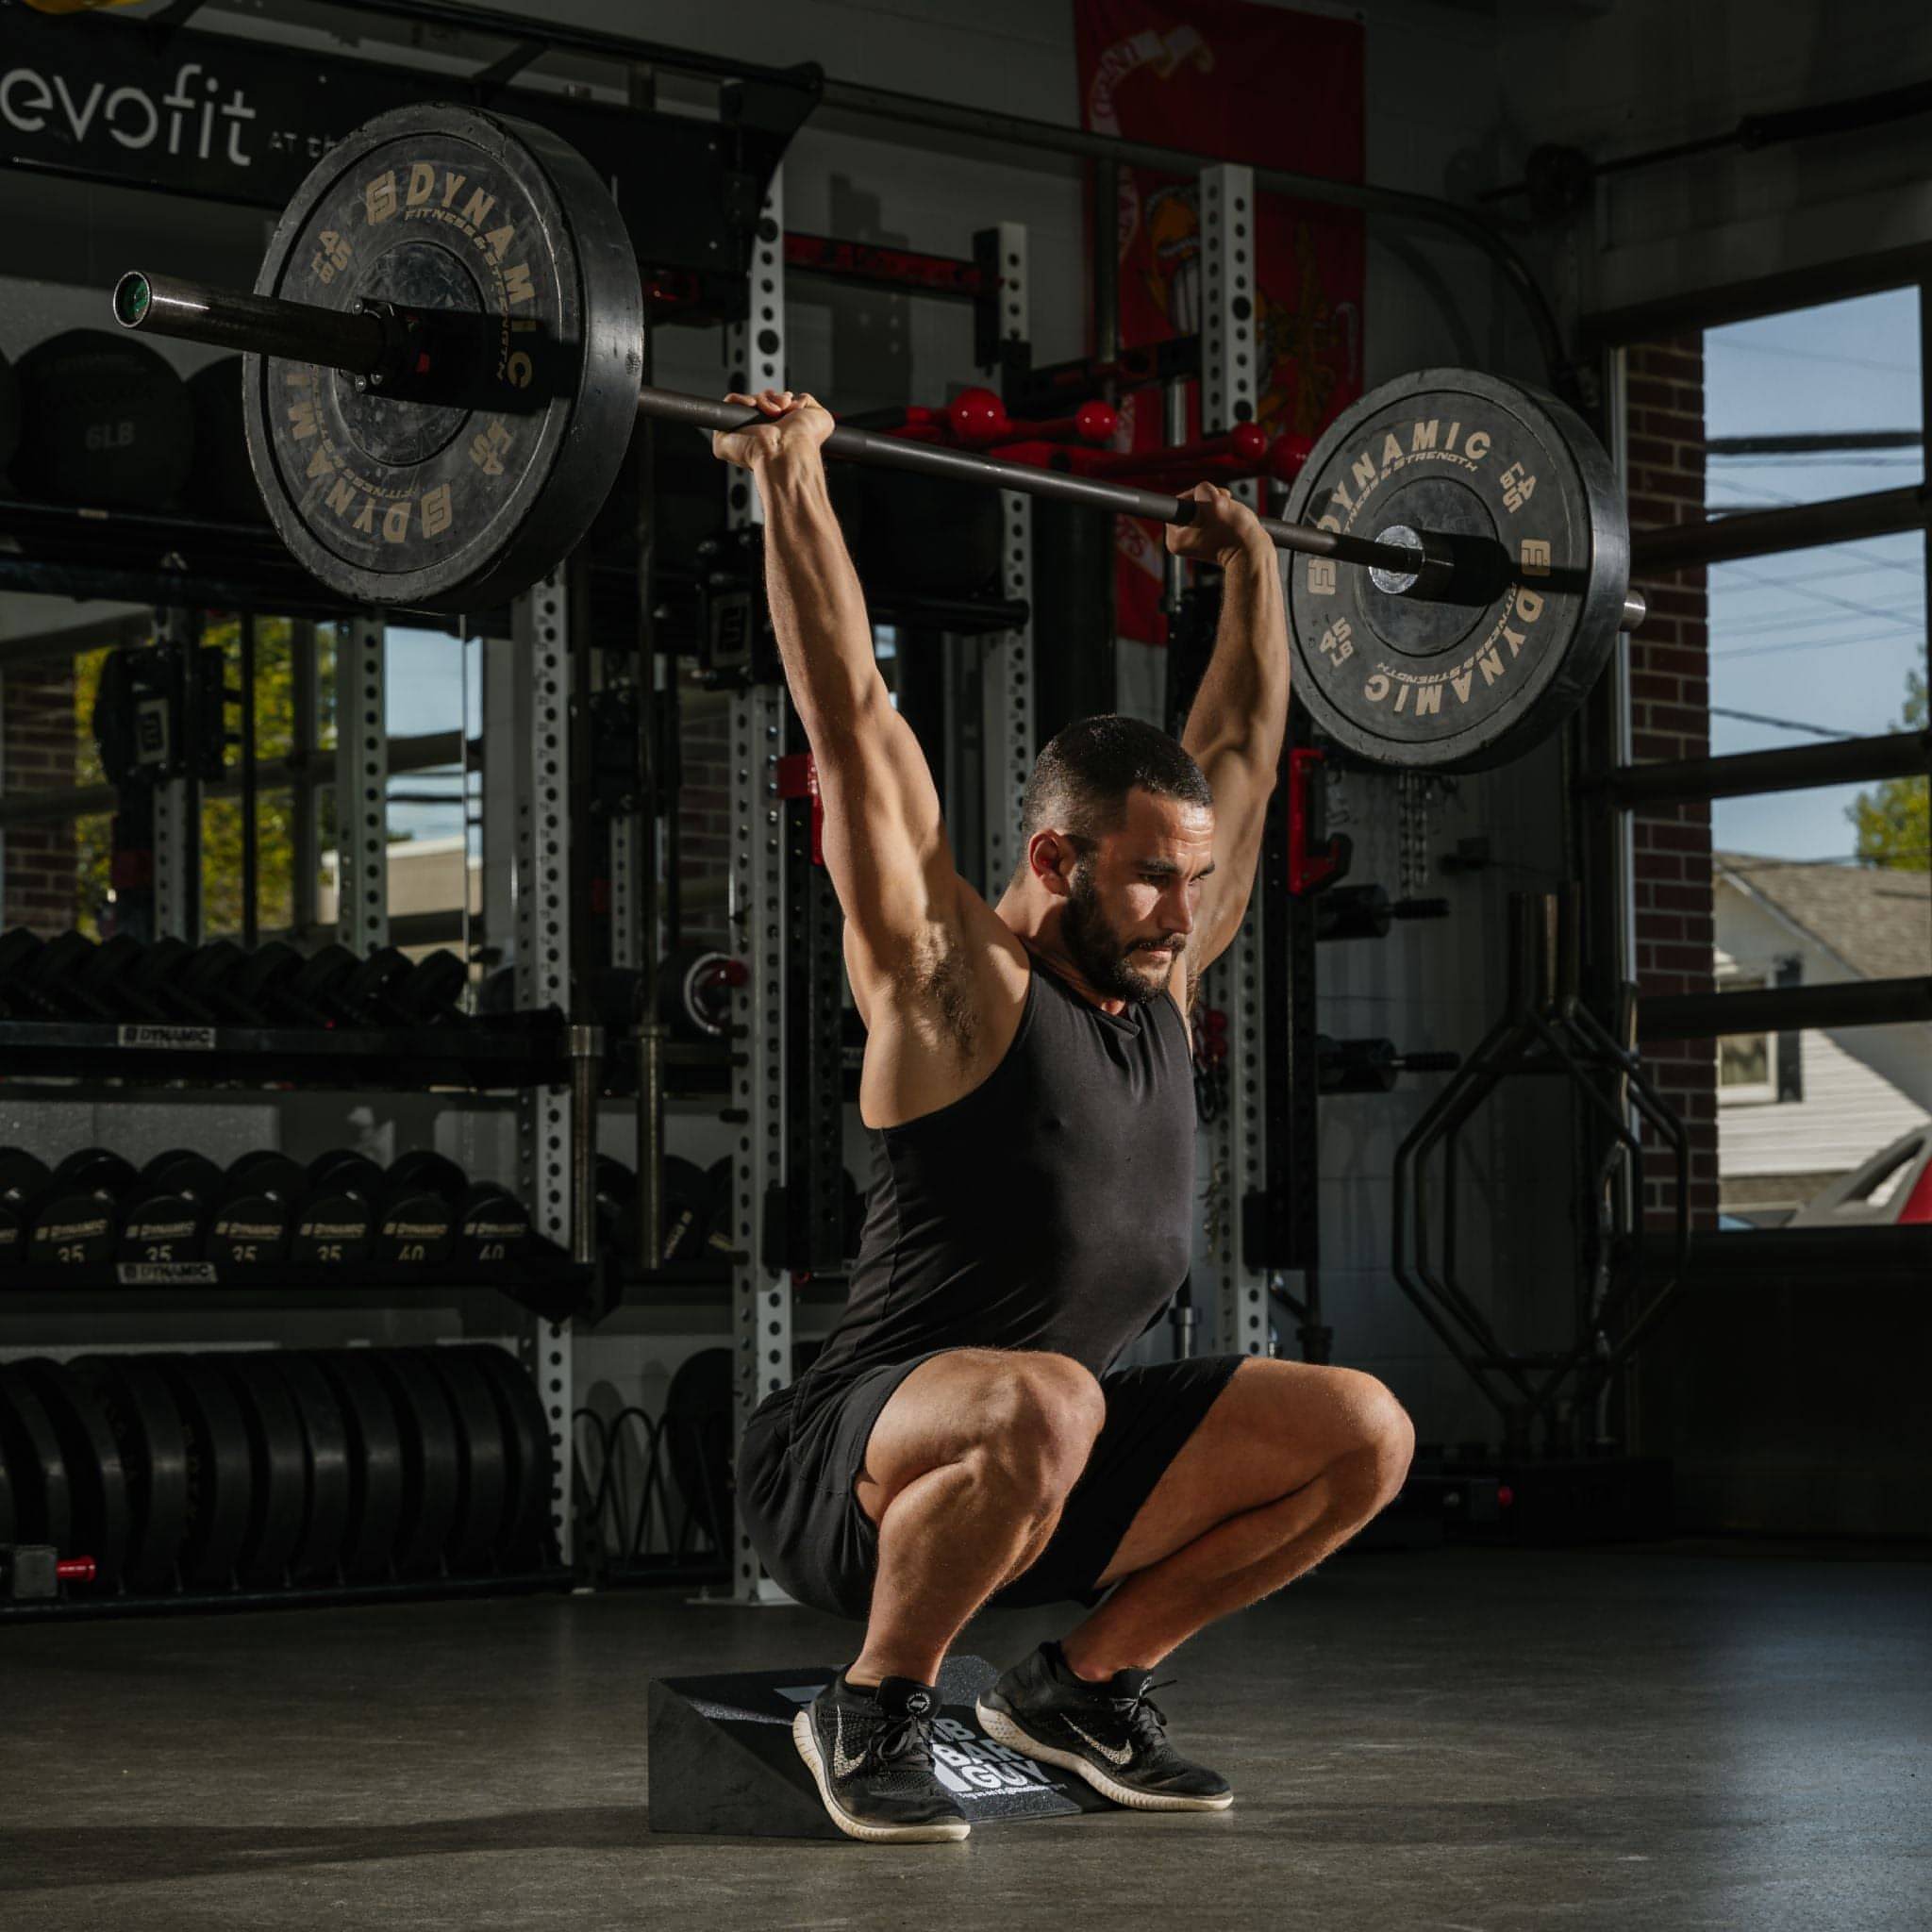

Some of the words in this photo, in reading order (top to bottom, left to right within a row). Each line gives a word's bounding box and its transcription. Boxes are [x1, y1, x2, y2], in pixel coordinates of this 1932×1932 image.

[0, 62, 256, 166] evofit
[318, 230, 353, 271] 45
[406, 163, 537, 390] DYNAMIC
[286, 374, 412, 544] DYNAMI
[1392, 450, 1479, 472] STRENGTH
[1499, 461, 1524, 487] LB
[1502, 475, 1538, 513] 45
[1320, 616, 1352, 654] 45
[1364, 586, 1545, 716] DYNAMIC
[1330, 641, 1355, 668] LB
[1376, 662, 1461, 685] STRENGTH
[961, 1758, 1053, 1790] GUY
